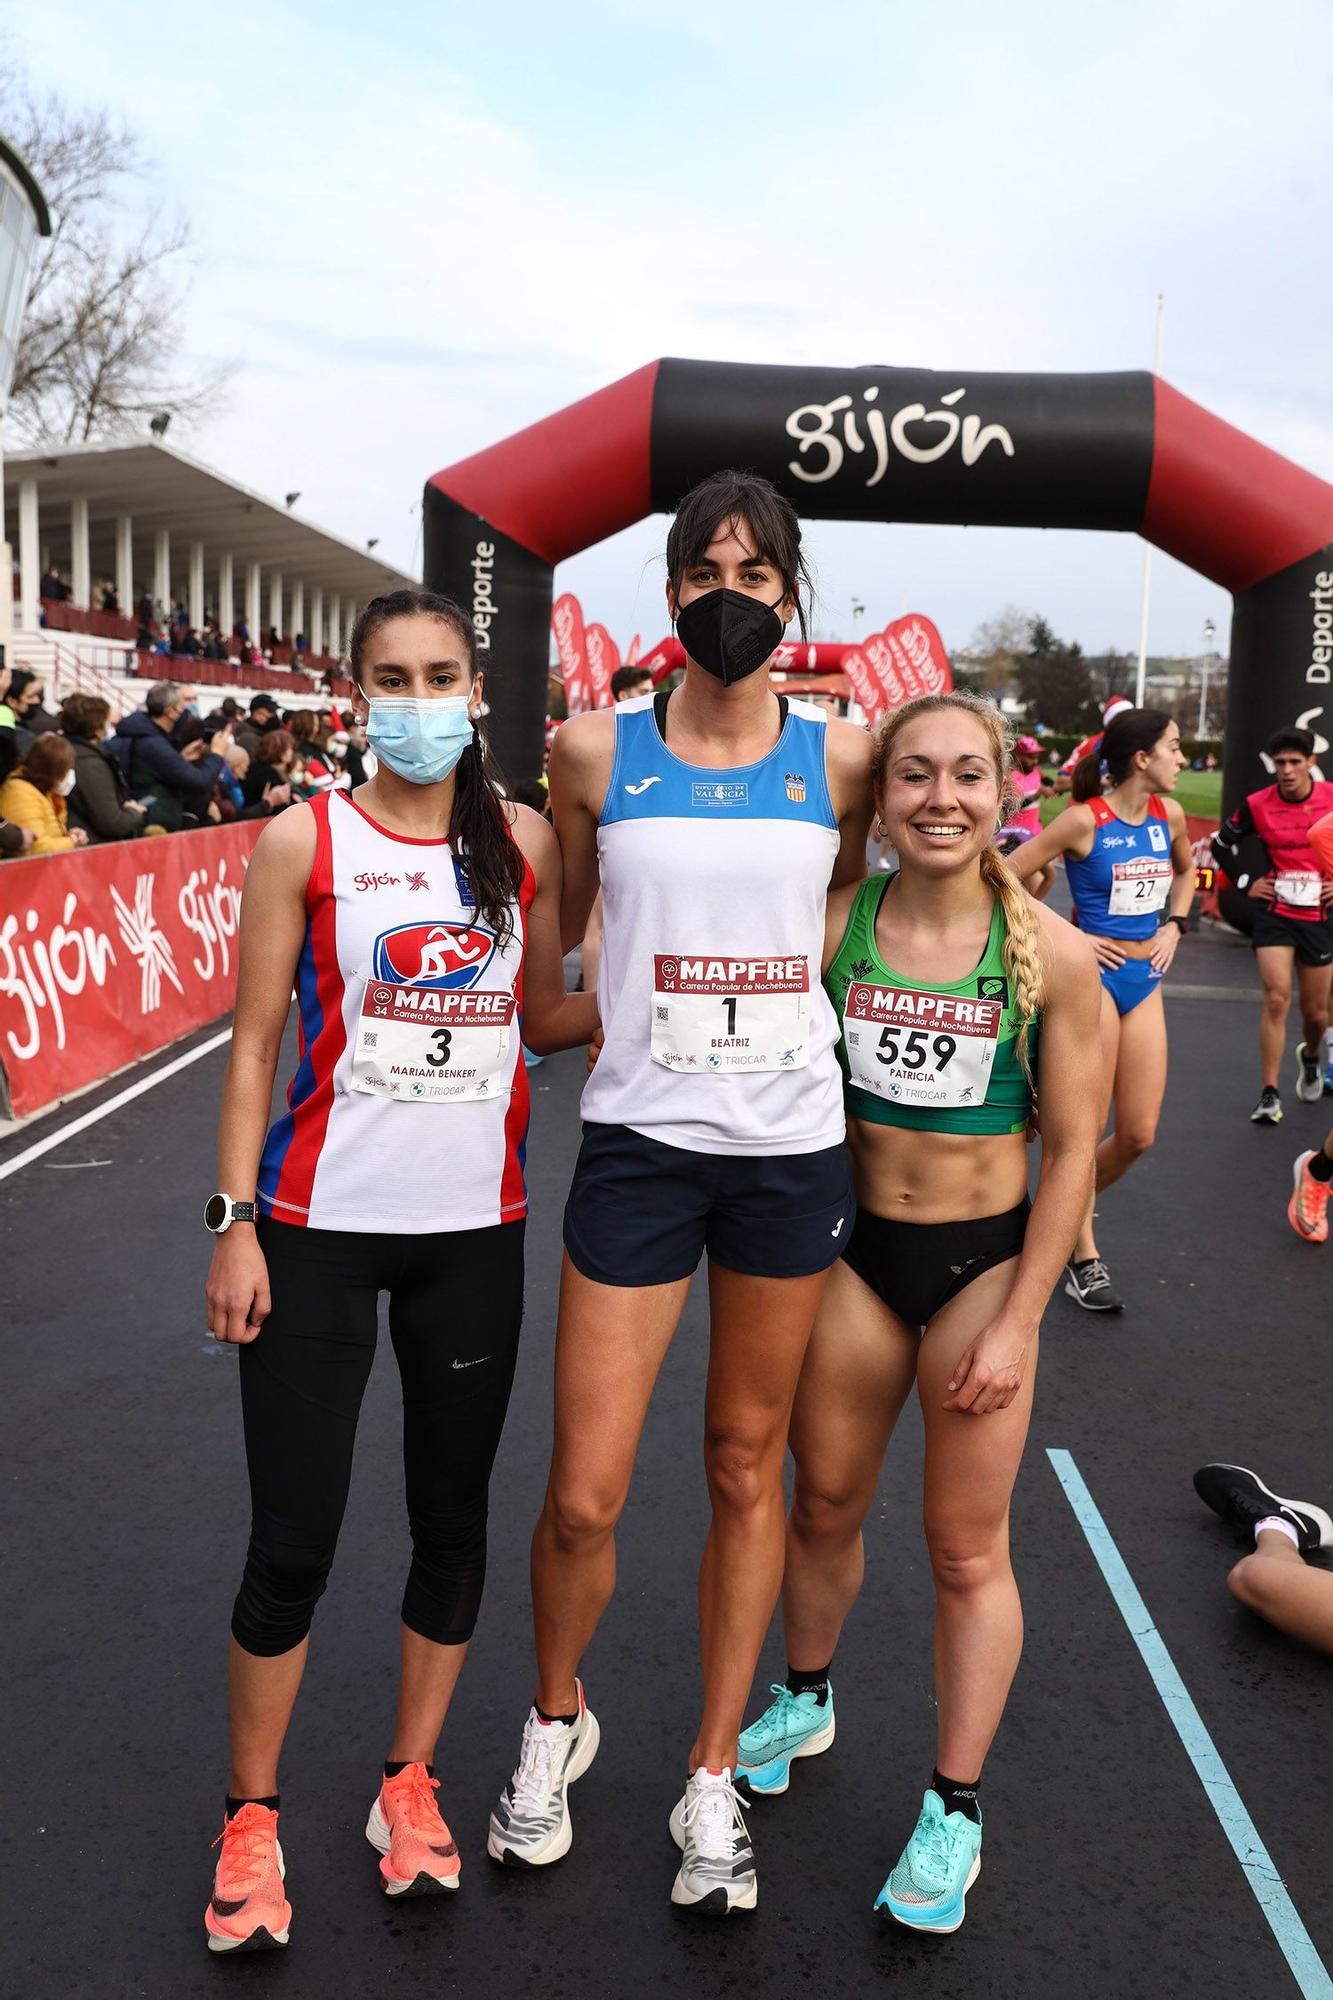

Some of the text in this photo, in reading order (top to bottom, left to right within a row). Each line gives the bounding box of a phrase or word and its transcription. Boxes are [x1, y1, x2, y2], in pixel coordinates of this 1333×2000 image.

[786, 386, 1015, 487] gijón
[470, 541, 499, 649] Deporte
[1305, 571, 1333, 684] Deporte
[353, 872, 401, 891] gijón
[1135, 880, 1156, 899] 27
[680, 960, 805, 981] MAPFRE
[663, 981, 803, 992] 34 Carrera Popular de Nochebuena
[394, 989, 510, 1013] MAPFRE
[872, 990, 993, 1025] MAPFRE
[373, 1006, 388, 1016] 34
[393, 1009, 424, 1020] Carrera
[424, 1013, 453, 1024] Popular
[453, 1015, 464, 1023] de
[721, 997, 737, 1035] 1
[854, 1006, 991, 1035] 34 Carrera Popular de Nochebuena
[426, 1028, 452, 1067] 3
[710, 1038, 750, 1048] BEATRIZ
[875, 1026, 957, 1072] 559
[724, 1055, 767, 1065] TRIOCAR
[390, 1065, 477, 1078] MARIAM BENKERT
[889, 1068, 936, 1082] PATRICIA
[428, 1086, 466, 1096] TRIOCAR
[904, 1088, 948, 1100] TRIOCAR
